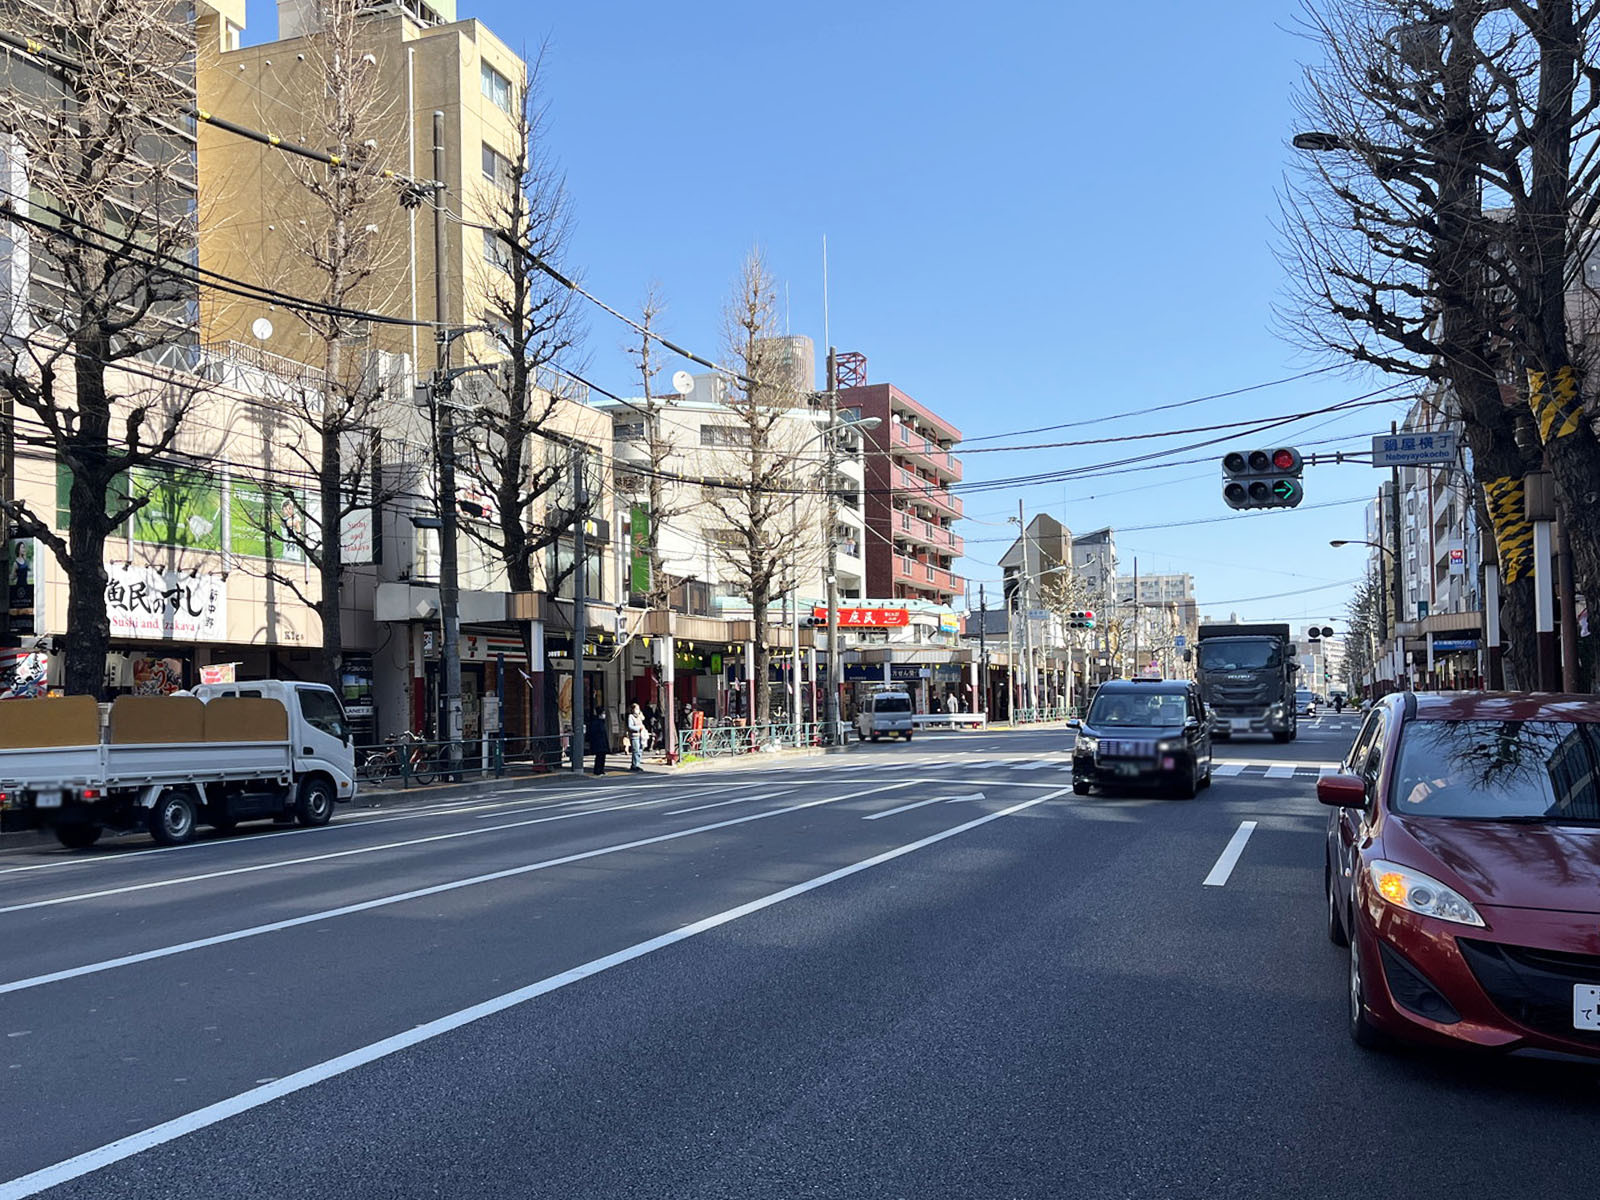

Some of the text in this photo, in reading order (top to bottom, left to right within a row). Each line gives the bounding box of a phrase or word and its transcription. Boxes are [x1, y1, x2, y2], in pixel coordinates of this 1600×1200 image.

[1383, 435, 1451, 451] 鍋屋横丁
[1385, 450, 1449, 461] Nabeyayokocho
[112, 615, 139, 629] Sushi
[141, 617, 159, 629] and
[1580, 1008, 1593, 1021] て
